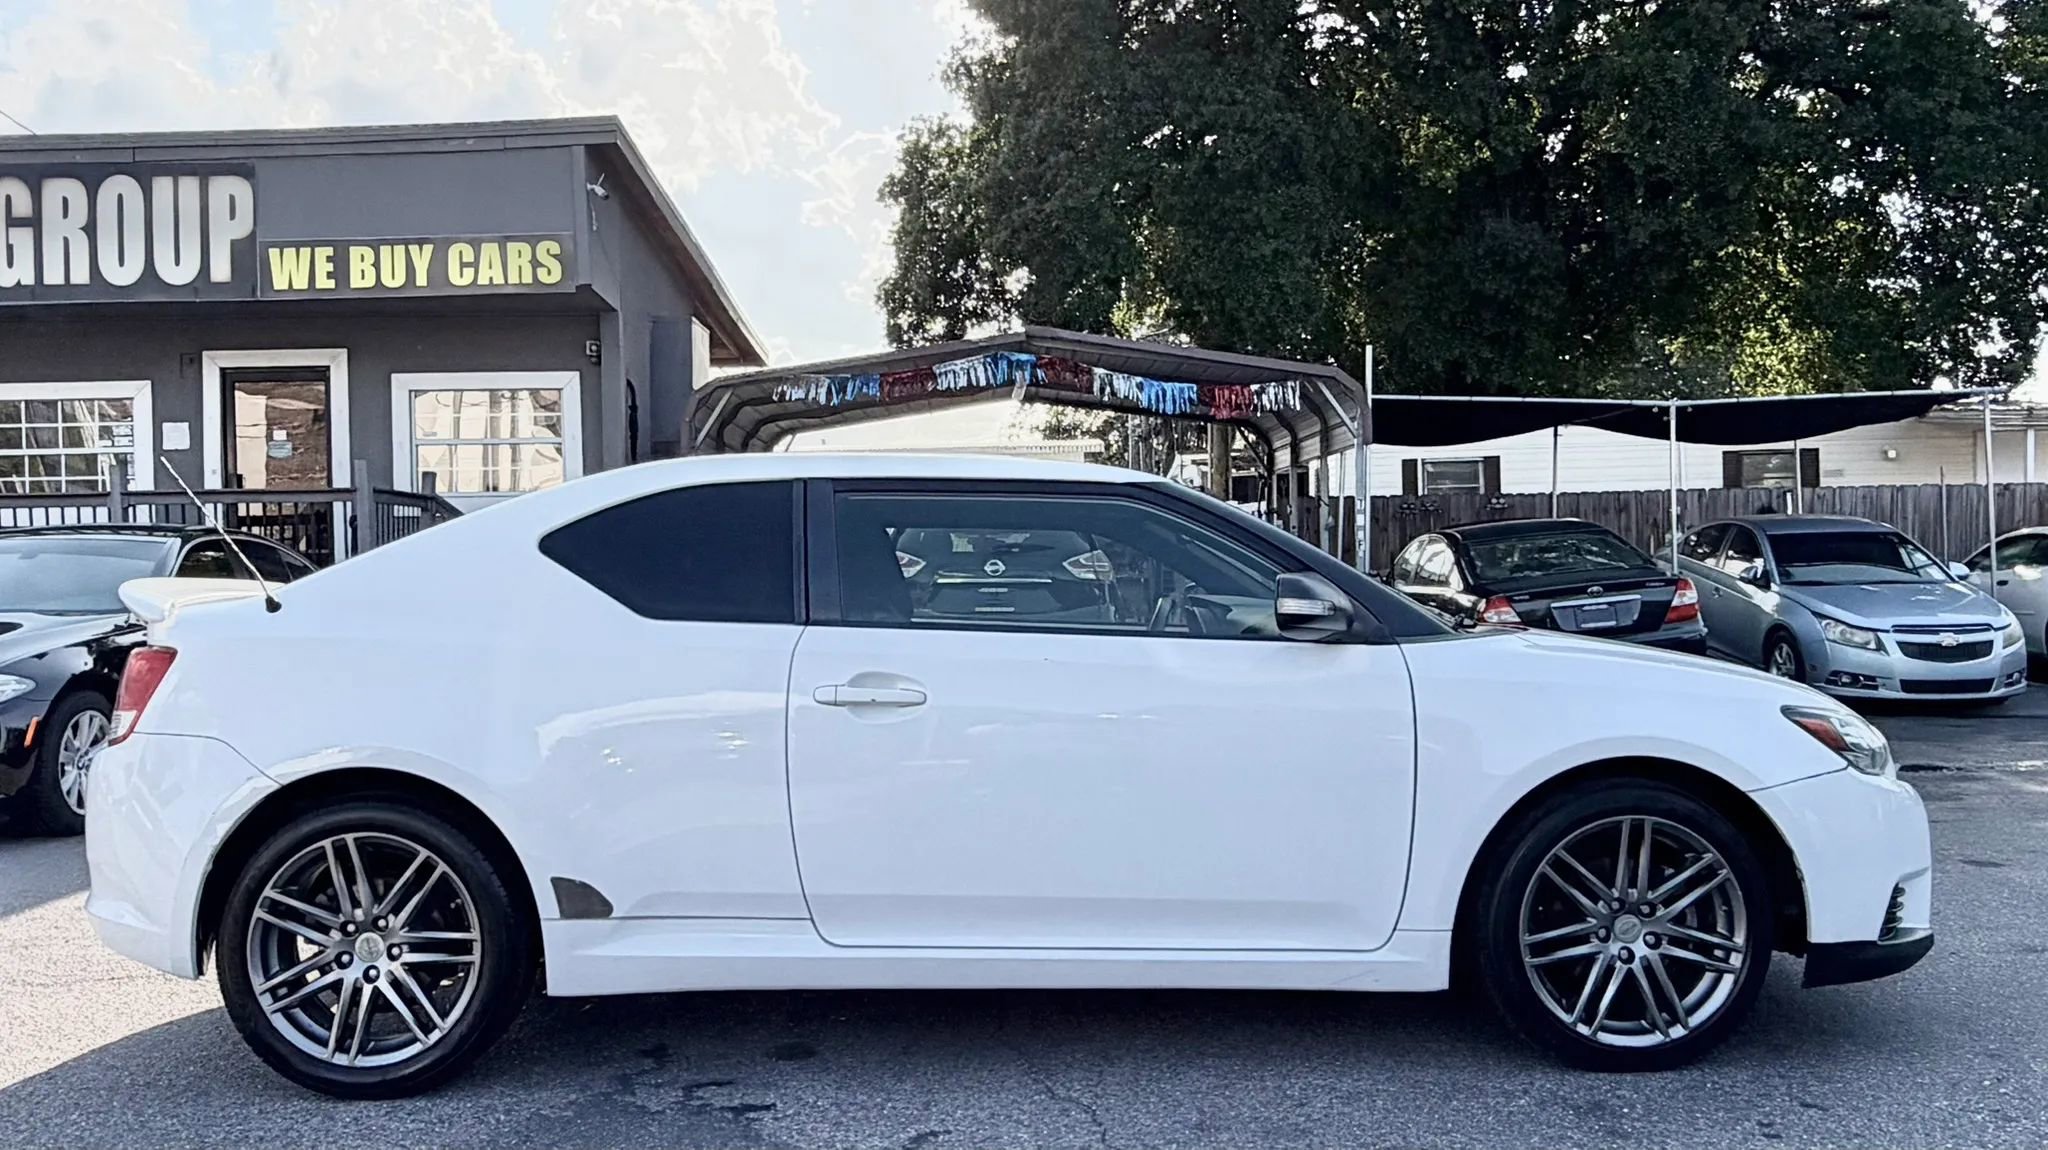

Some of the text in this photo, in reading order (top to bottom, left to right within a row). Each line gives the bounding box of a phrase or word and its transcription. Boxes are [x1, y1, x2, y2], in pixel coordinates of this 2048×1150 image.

[0, 174, 255, 288] GROUP
[268, 239, 563, 291] WE BUY CARS
